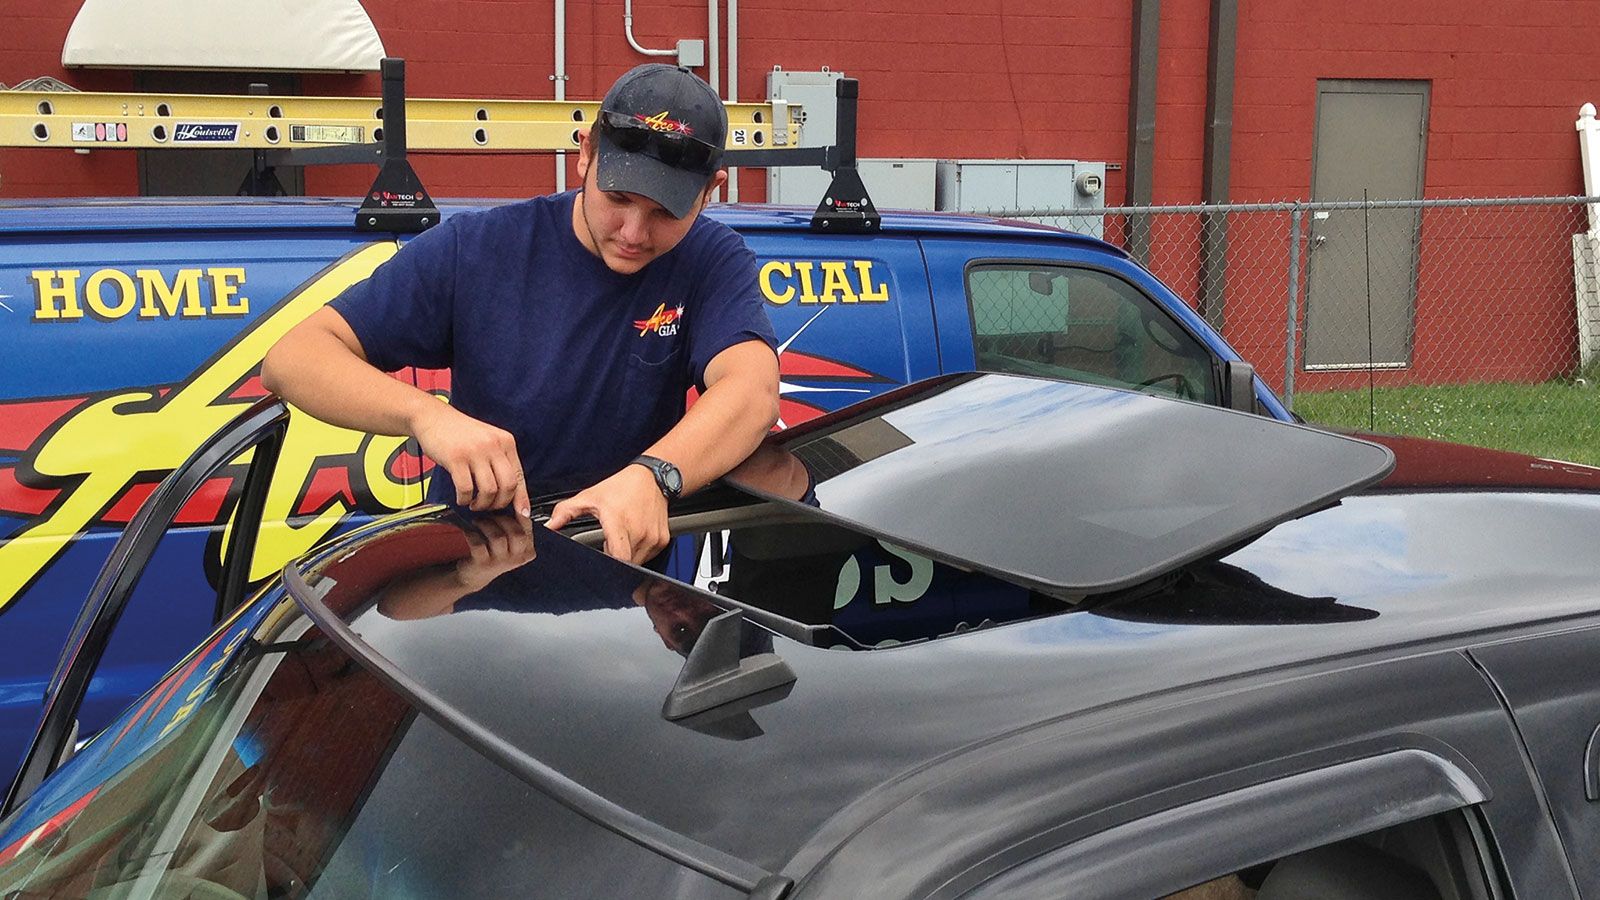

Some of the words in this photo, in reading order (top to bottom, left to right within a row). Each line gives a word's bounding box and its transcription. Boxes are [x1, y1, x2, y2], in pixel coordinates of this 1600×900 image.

[645, 111, 674, 131] Ace
[182, 125, 235, 139] Louisville
[29, 266, 250, 321] HOME
[639, 302, 673, 338] Ace
[658, 324, 677, 337] GIA
